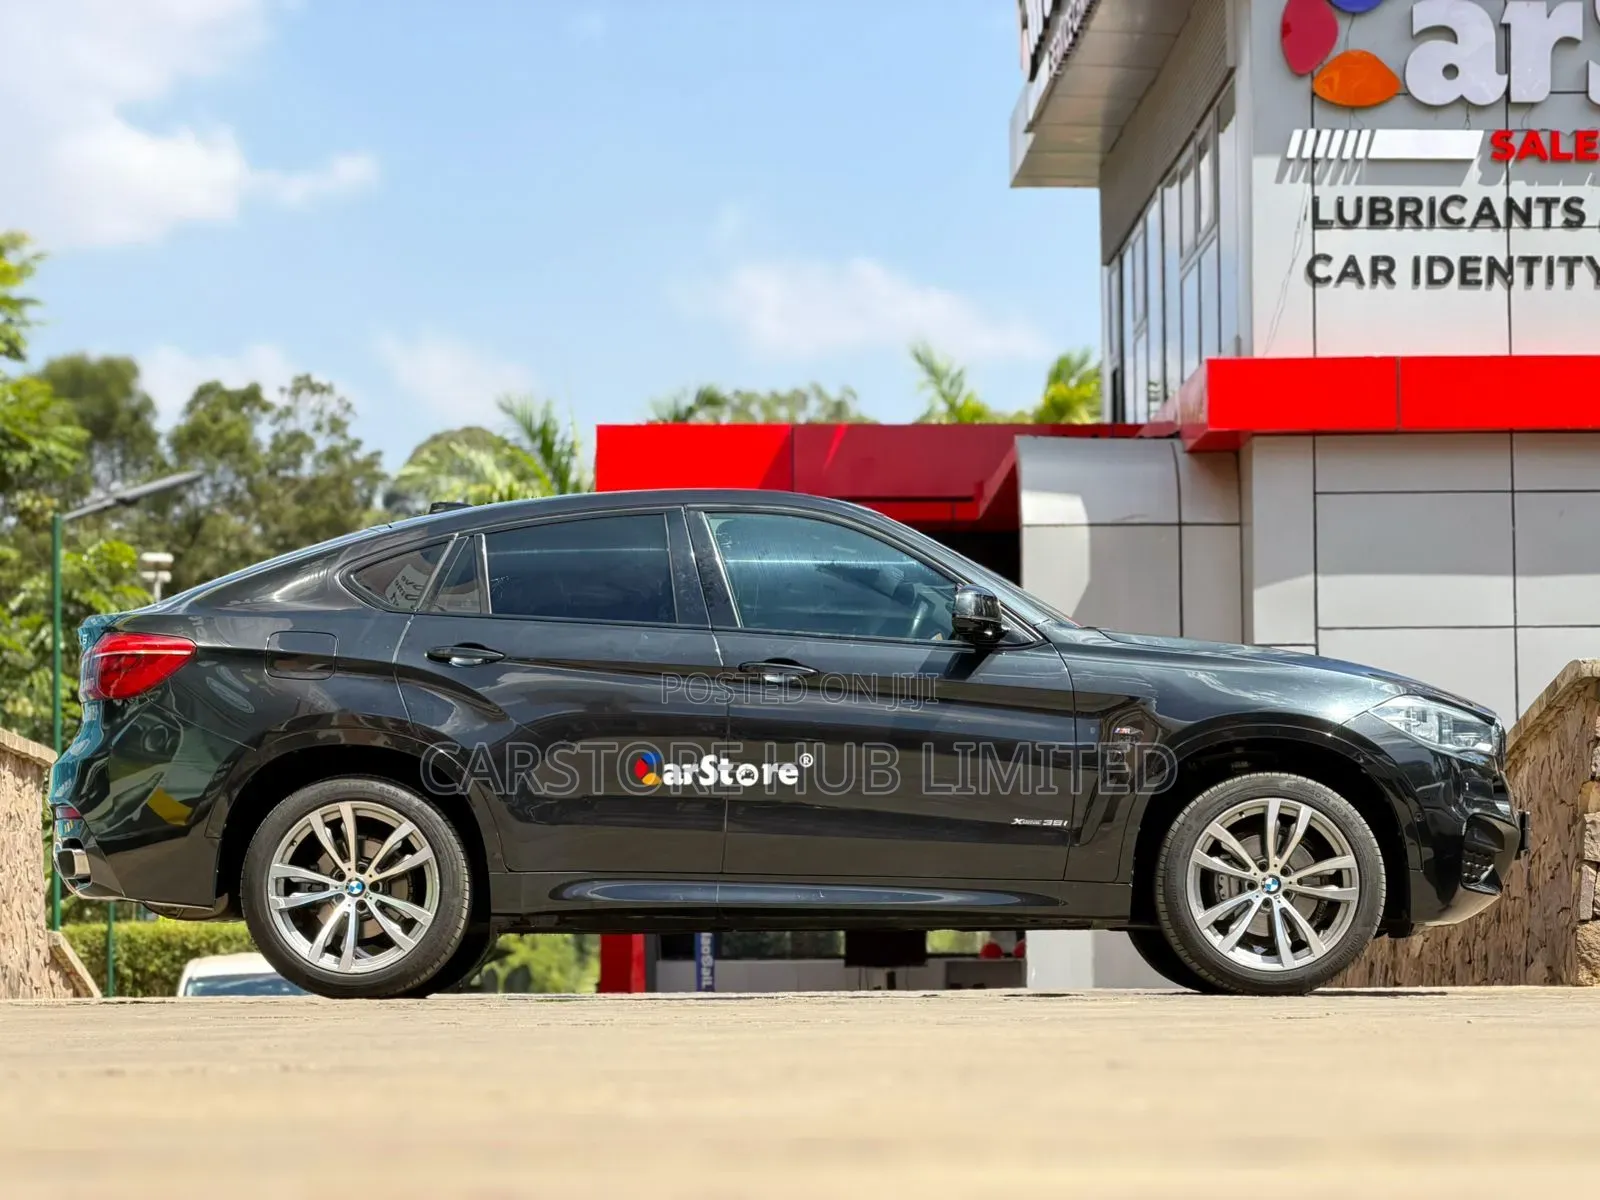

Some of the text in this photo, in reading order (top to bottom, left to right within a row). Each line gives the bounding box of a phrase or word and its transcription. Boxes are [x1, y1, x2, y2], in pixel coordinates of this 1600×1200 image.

[1490, 129, 1600, 161] SALE
[1312, 195, 1586, 230] LUBRICANTS
[1306, 253, 1396, 287] CAR
